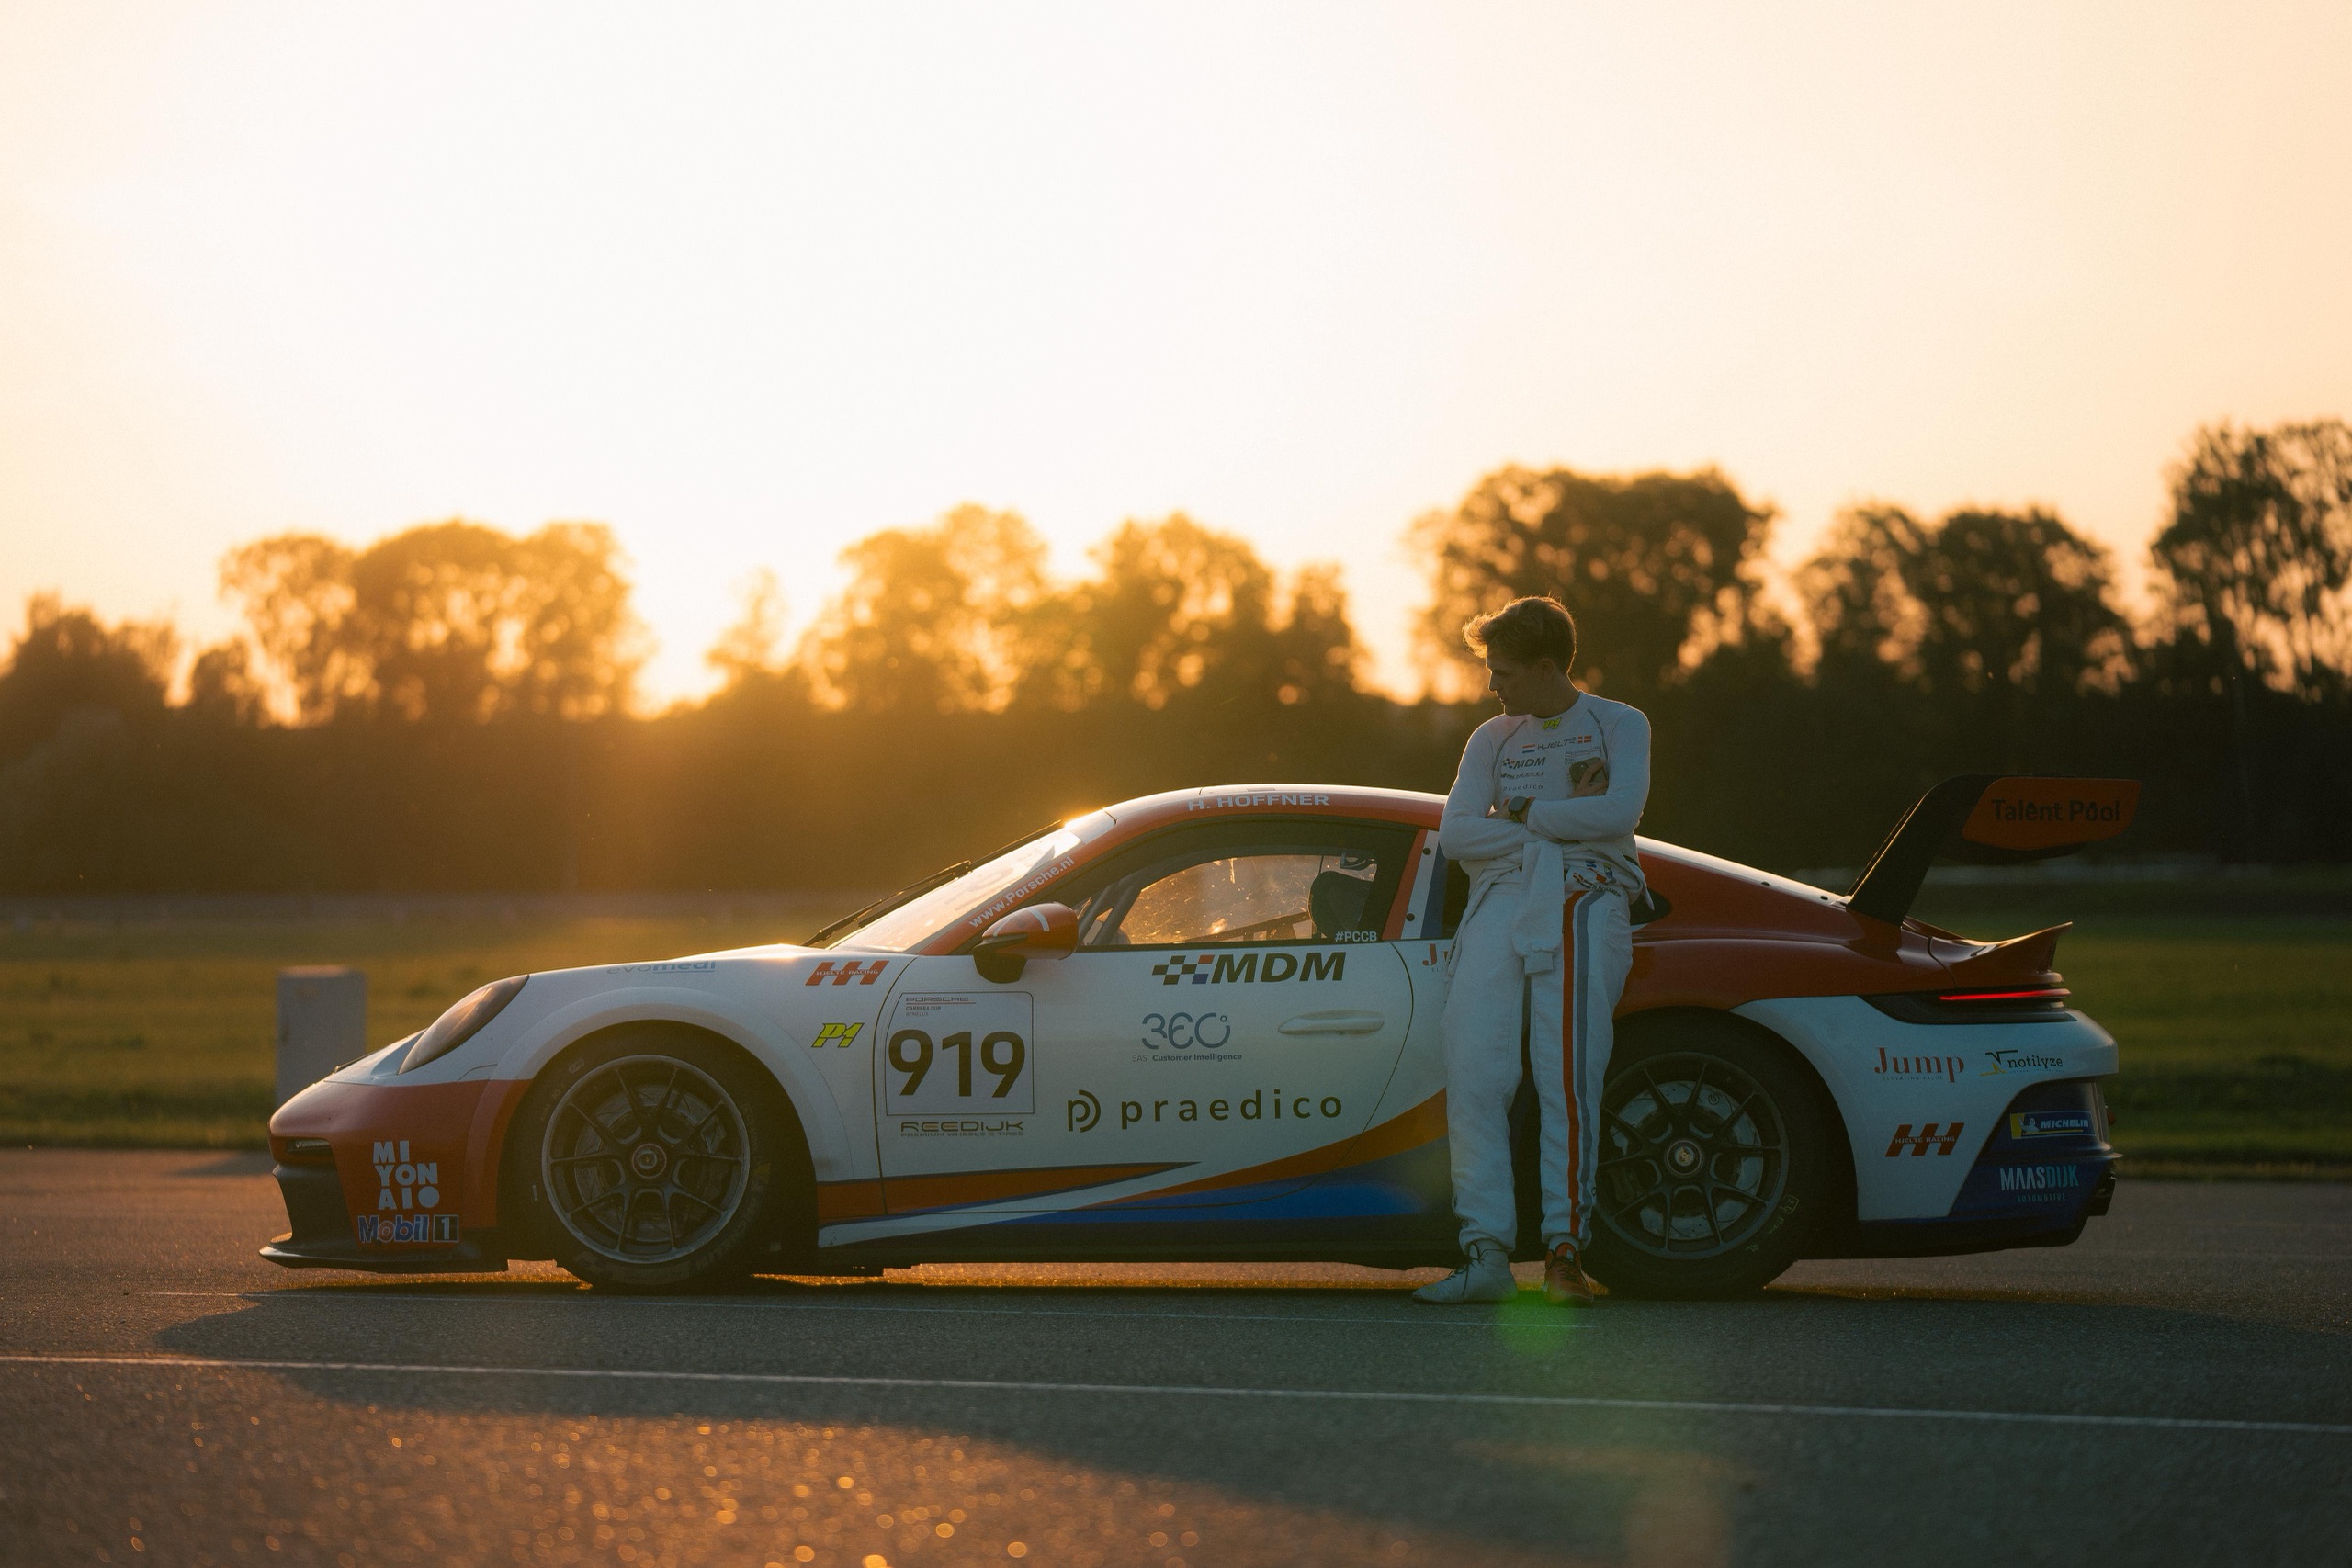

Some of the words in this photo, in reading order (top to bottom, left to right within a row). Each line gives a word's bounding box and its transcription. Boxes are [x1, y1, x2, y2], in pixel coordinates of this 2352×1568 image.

[1512, 756, 1546, 770] MDM
[1188, 799, 1211, 811] H.
[1216, 795, 1329, 808] HOFFNER
[968, 855, 1076, 928] www.Porsche.nl
[1335, 931, 1377, 942] #PCCB
[1211, 952, 1347, 984] MDM
[811, 1022, 865, 1048] P1
[888, 1029, 1026, 1098] 919
[1132, 1054, 1148, 1062] SAS
[1152, 1054, 1192, 1062] Customer
[1193, 1053, 1242, 1062] Intelligence
[1873, 1047, 1965, 1083] Jump
[2007, 1055, 2064, 1069] notilyze
[1121, 1089, 1343, 1130] praedico
[900, 1121, 1024, 1132] REEDIJK
[2040, 1118, 2089, 1130] MICHELIN
[1999, 1164, 2079, 1190] MAASDIJK
[2016, 1192, 2066, 1203] AUTOMOTIVE
[357, 1214, 429, 1243] Mobil
